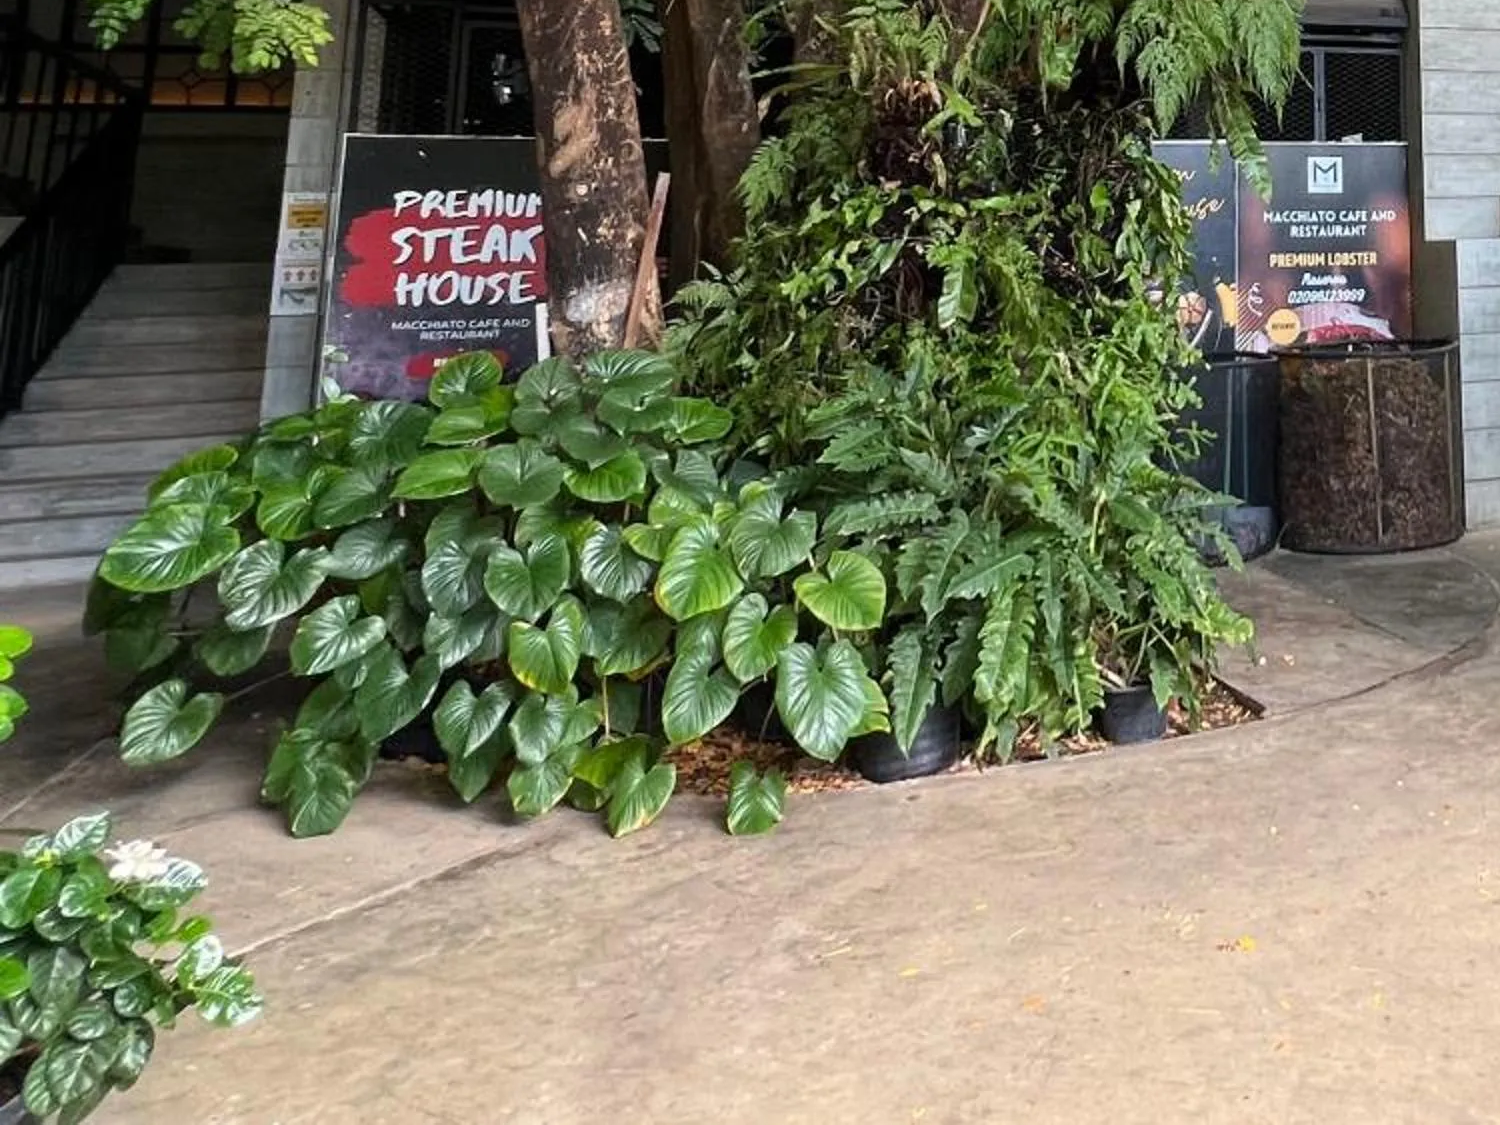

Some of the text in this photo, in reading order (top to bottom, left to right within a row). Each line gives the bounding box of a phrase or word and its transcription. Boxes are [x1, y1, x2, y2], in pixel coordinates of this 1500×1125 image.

[1313, 160, 1337, 183] M
[1263, 210, 1397, 223] MACCHIATO CAFE AND
[1290, 224, 1367, 238] RESTAURANT
[391, 224, 544, 264] STEAK
[1269, 251, 1377, 268] PREMIUM LOBSTER
[393, 270, 537, 307] HOUSE
[391, 318, 531, 330] MACCHIATO CAFE AND
[419, 329, 501, 341] RESTAURANT
